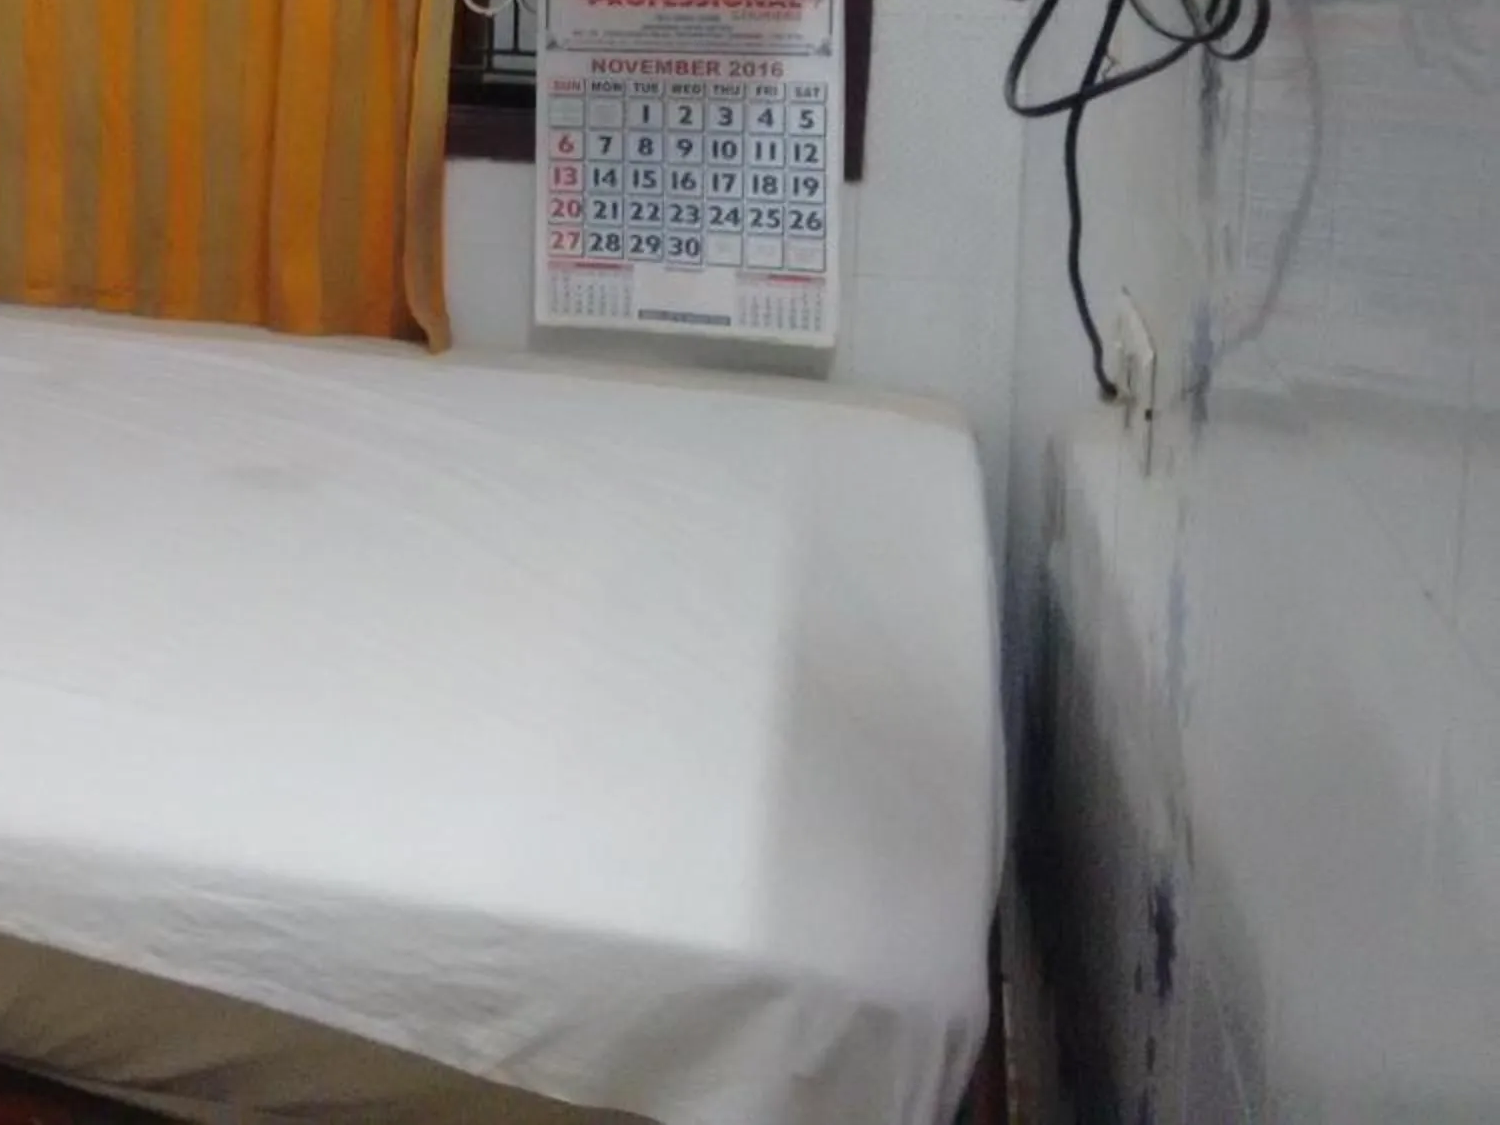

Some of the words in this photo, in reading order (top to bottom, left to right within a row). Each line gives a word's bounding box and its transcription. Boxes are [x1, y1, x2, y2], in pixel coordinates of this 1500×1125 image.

[591, 58, 721, 77] NOVEMBER
[729, 61, 784, 78] 2016
[552, 81, 581, 92] SUN
[590, 82, 622, 93] MON
[633, 82, 658, 94] TUE
[671, 84, 702, 95] WED
[712, 85, 741, 96] THU
[755, 86, 777, 97] FRI
[795, 88, 820, 98] SAT
[642, 106, 650, 123] 1
[678, 106, 693, 125] 2
[718, 108, 733, 126] 3
[757, 108, 774, 126] 4
[799, 110, 814, 128] 5
[558, 134, 575, 152] 6
[598, 136, 612, 153] 7
[637, 137, 653, 156] 8
[676, 139, 693, 157] 9
[712, 140, 737, 158] 10
[754, 141, 777, 159] 11
[793, 143, 819, 164] 12
[553, 166, 577, 184] 13
[592, 167, 618, 187] 14
[632, 169, 657, 189] 15
[671, 171, 697, 190] 16
[712, 172, 737, 192] 17
[752, 175, 777, 195] 18
[793, 177, 819, 196] 19
[551, 199, 580, 218] 20
[593, 201, 619, 220] 21
[629, 202, 660, 221] 22
[669, 204, 700, 224] 23
[709, 206, 741, 225] 24
[750, 208, 781, 228] 25
[789, 210, 822, 230] 26
[551, 231, 580, 250] 27
[588, 233, 620, 252] 28
[630, 235, 660, 254] 29
[667, 237, 700, 256] 30
